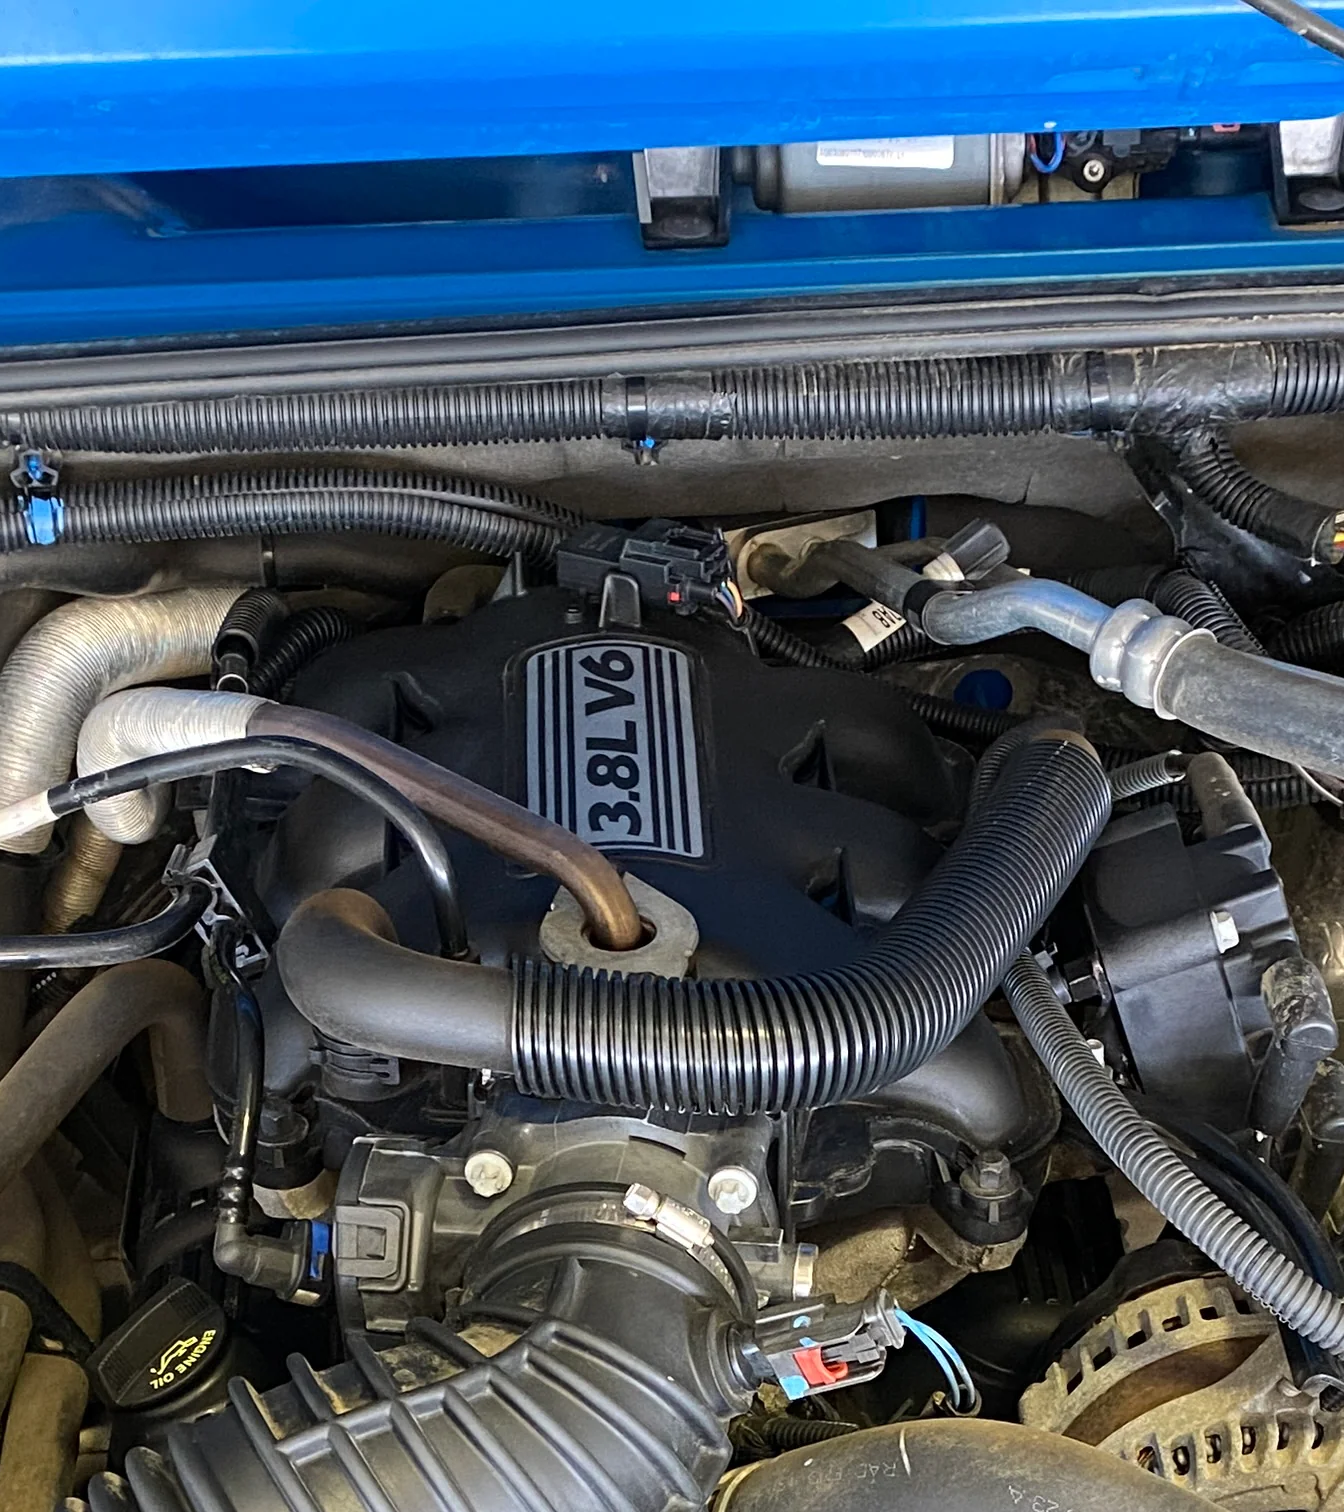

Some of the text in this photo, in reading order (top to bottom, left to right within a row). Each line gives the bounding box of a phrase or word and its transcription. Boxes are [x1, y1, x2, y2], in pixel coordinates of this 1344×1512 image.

[579, 650, 642, 836] 3.8L V6
[149, 1329, 216, 1389] ENGINE OIL
